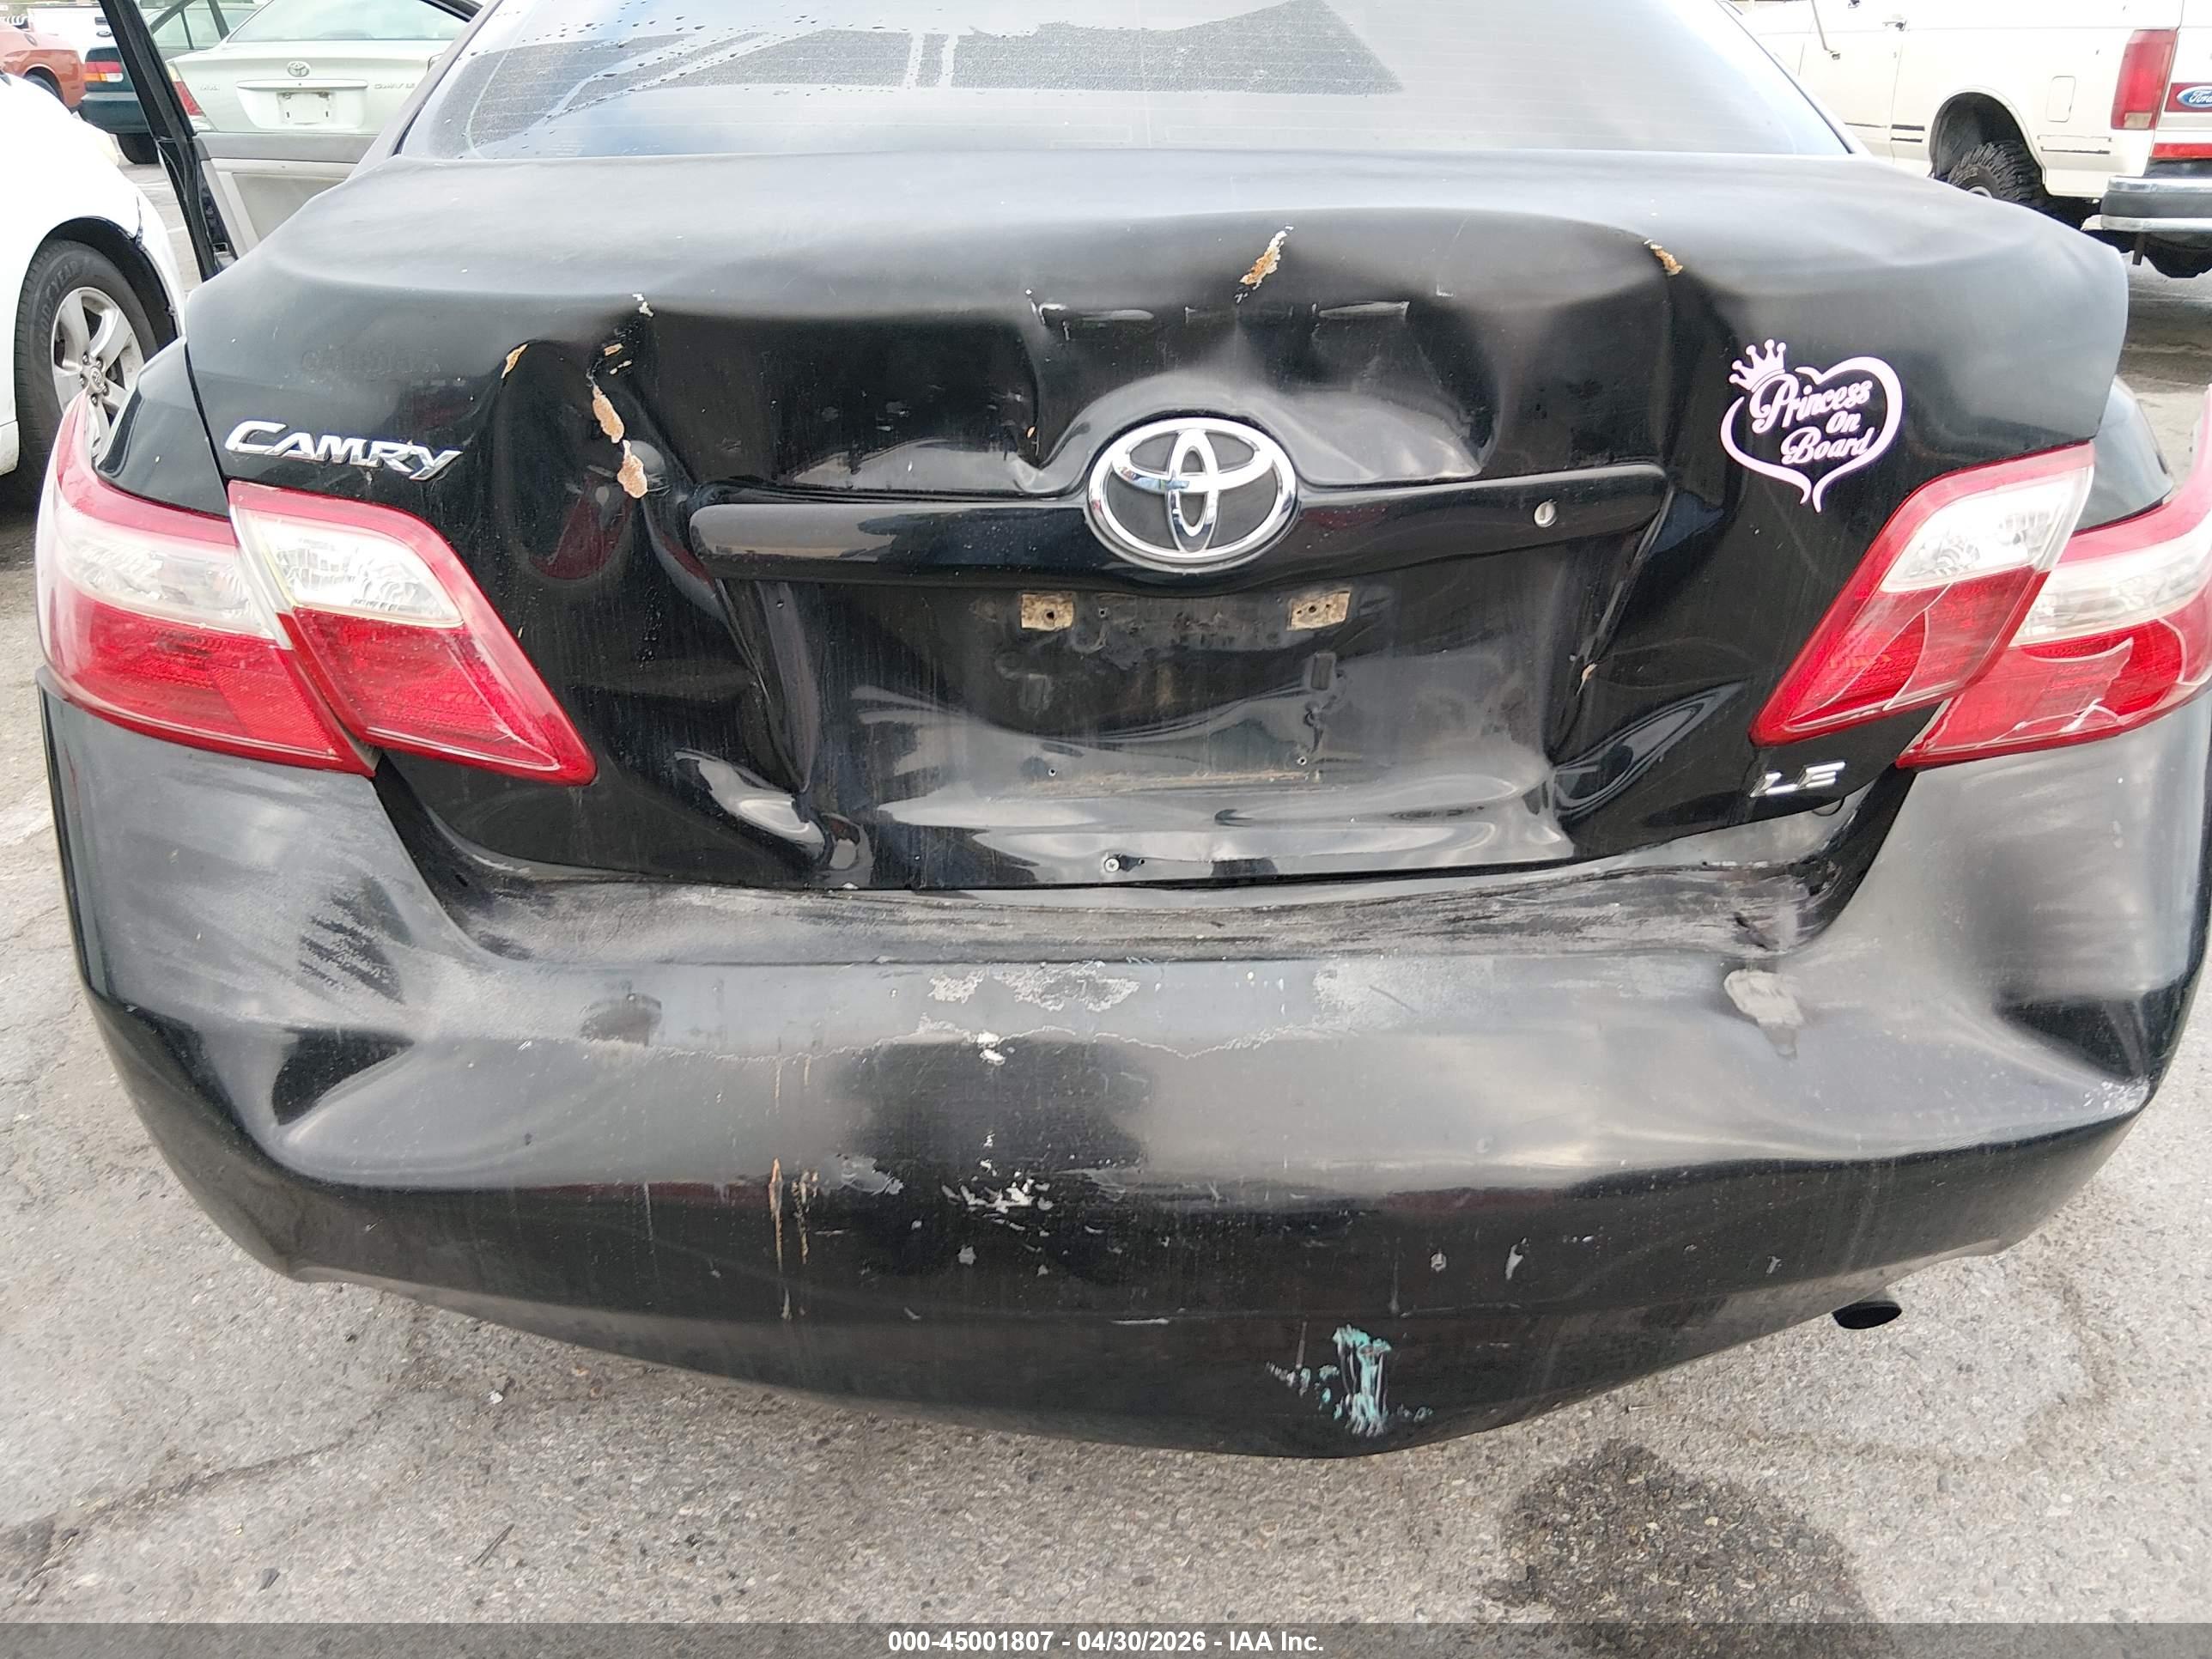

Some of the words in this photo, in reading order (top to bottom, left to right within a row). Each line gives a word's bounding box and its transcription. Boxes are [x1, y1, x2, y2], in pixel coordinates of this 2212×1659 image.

[1749, 373, 1873, 434] Princess
[225, 420, 464, 481] CAMRY
[1780, 426, 1875, 465] Board
[1749, 761, 1847, 798] LE
